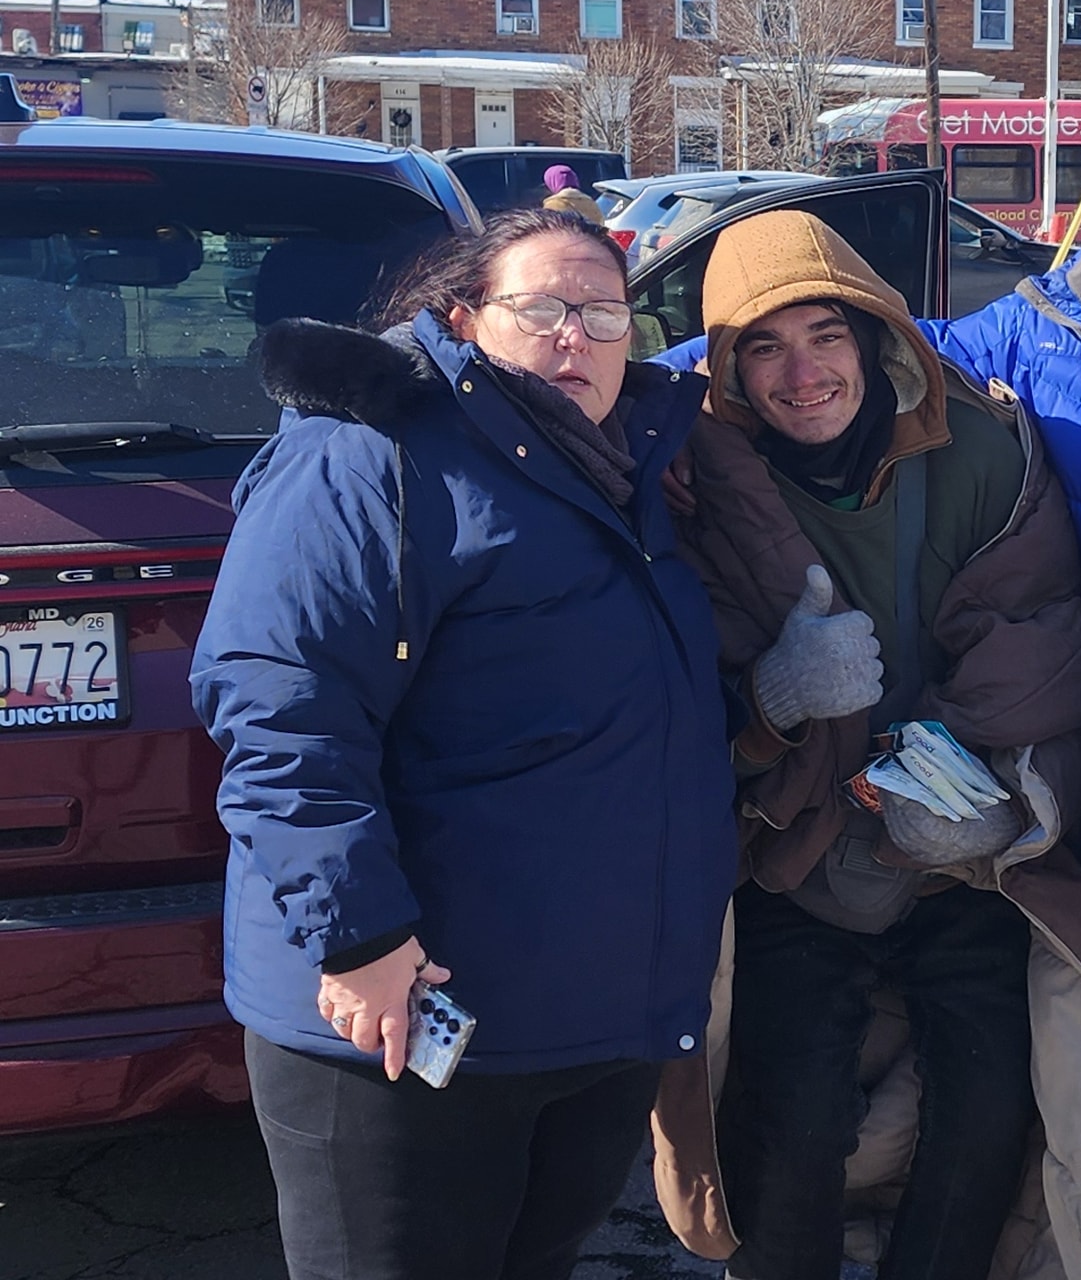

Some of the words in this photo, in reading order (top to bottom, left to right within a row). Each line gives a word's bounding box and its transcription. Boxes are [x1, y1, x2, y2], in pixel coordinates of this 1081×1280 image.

[28, 608, 60, 621] MD
[87, 616, 104, 629] 26
[0, 702, 117, 727] UNCTION
